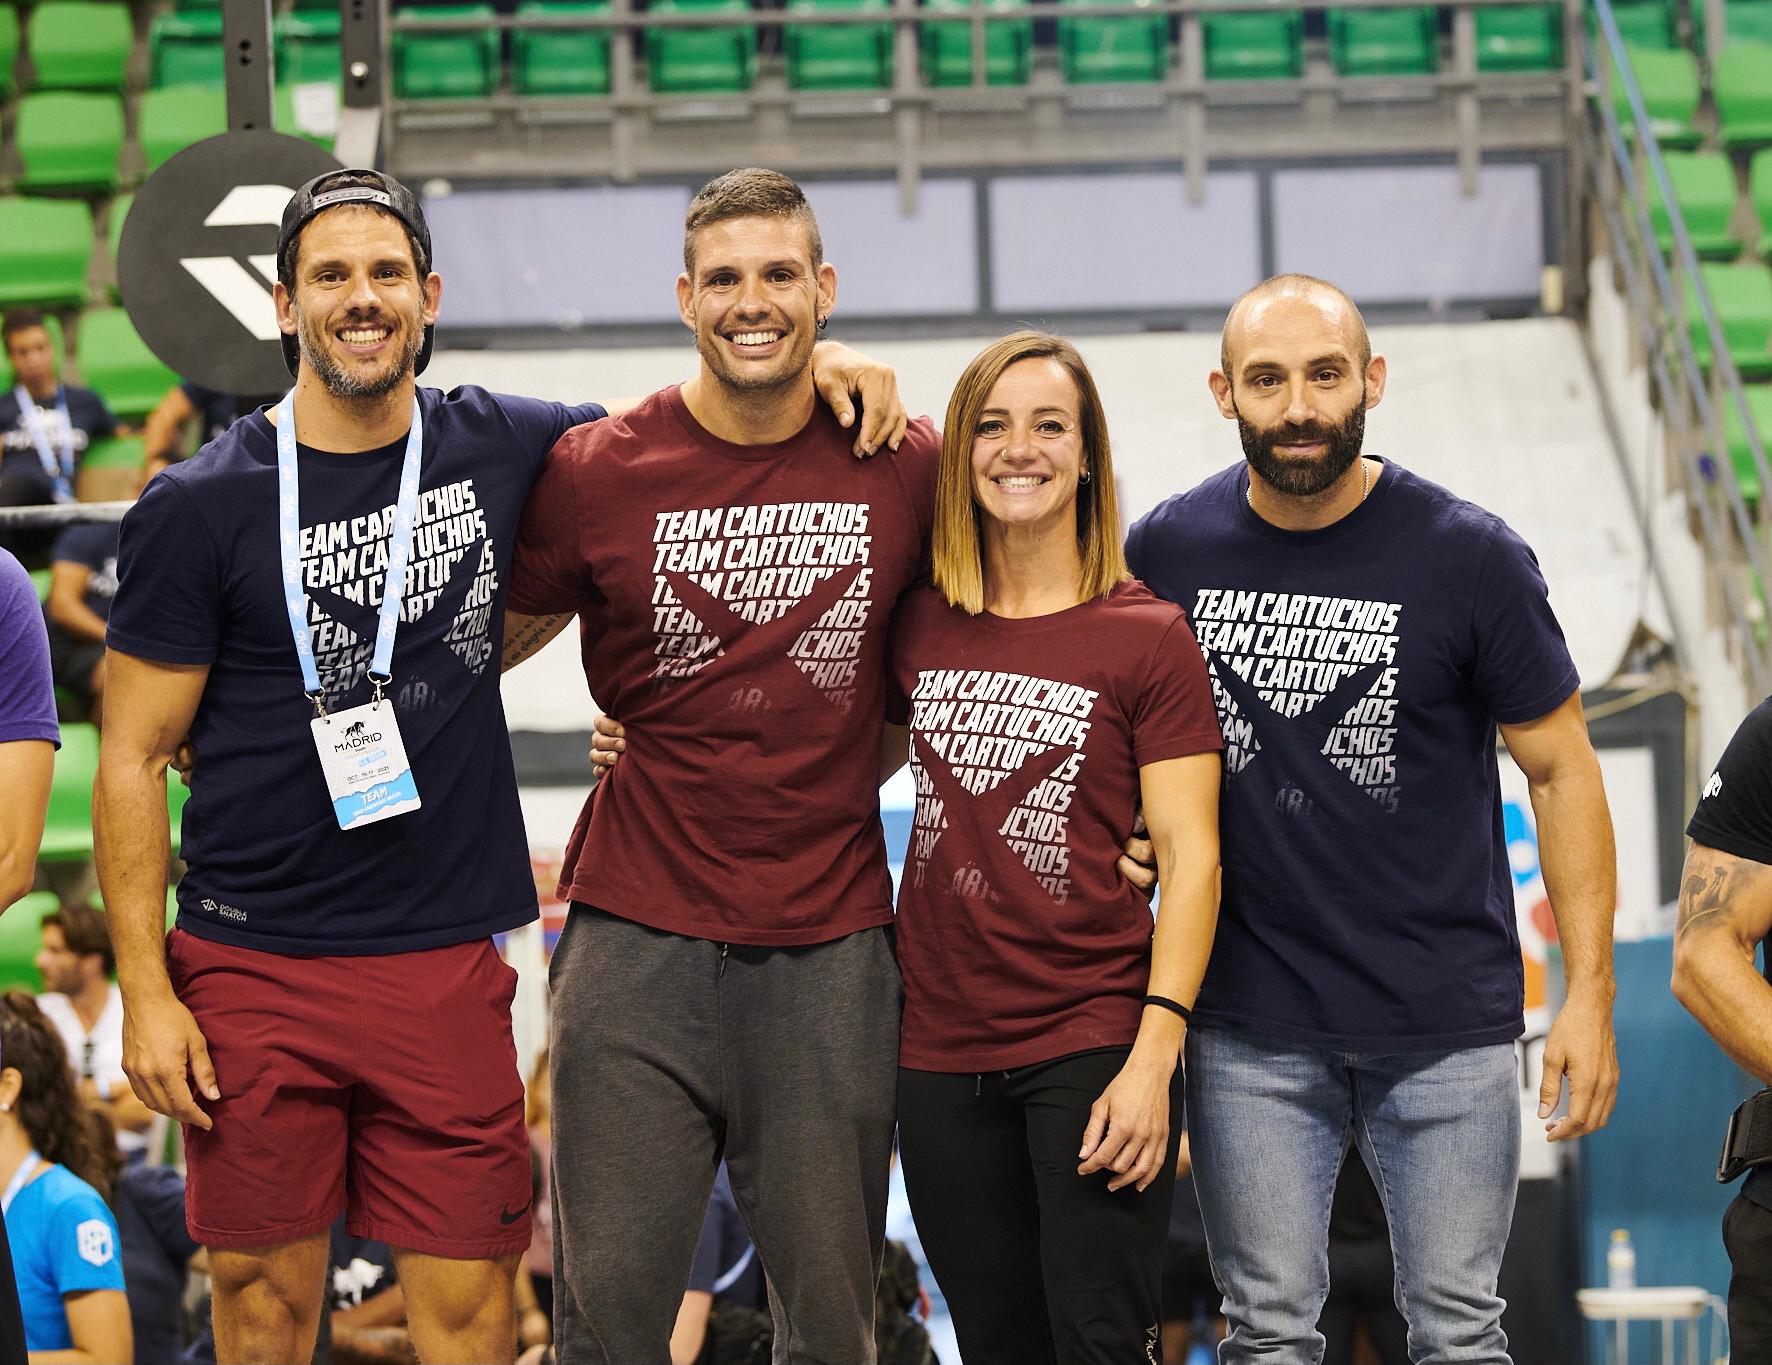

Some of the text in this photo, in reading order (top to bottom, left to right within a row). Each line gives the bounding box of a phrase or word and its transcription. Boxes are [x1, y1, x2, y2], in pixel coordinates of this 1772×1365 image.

[300, 520, 348, 559] EAM
[653, 502, 869, 543] TEAM CARTUCHOS
[652, 535, 872, 574] TEAM CARTUCHOS
[1193, 588, 1402, 634] TEAM CARTUCHOS
[1195, 620, 1257, 654] TEAM
[1253, 624, 1400, 665] CARTUCHOS
[911, 670, 1099, 719] TEAM CARTUCHOS
[334, 732, 382, 753] MADRID
[909, 701, 958, 731] TEAM
[952, 701, 1092, 751] CARTUCHOS
[361, 786, 388, 806] TEAM
